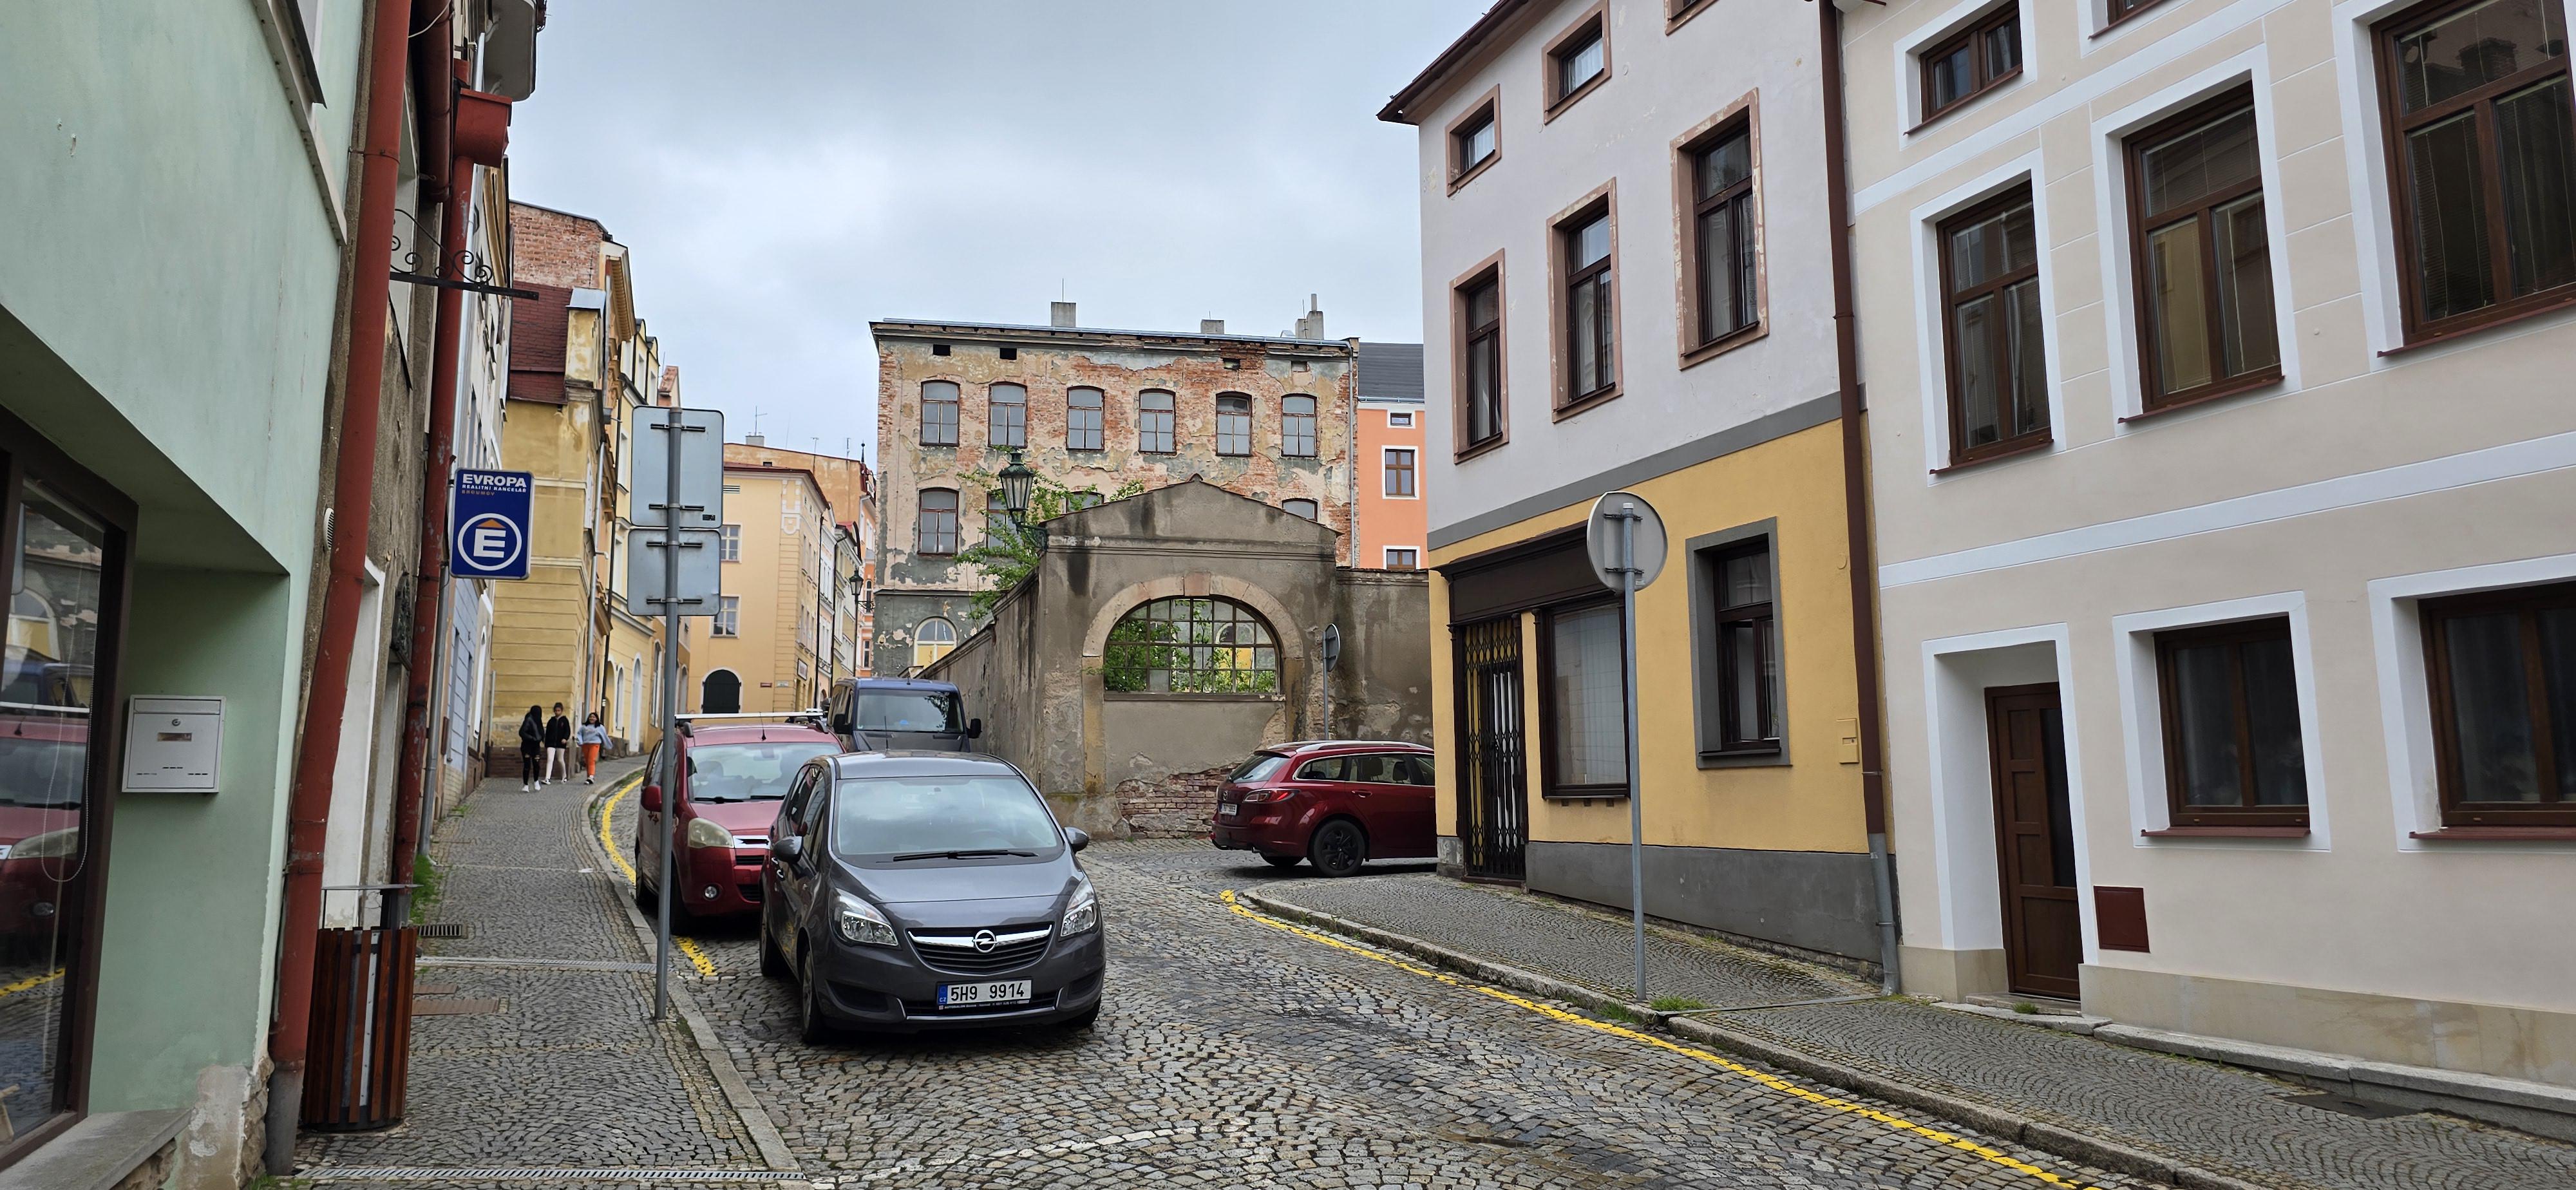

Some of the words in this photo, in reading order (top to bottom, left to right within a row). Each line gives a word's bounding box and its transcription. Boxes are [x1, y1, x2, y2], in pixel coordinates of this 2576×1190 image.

[463, 473, 527, 487] EVROPA
[473, 528, 506, 558] E
[951, 985, 978, 1001] 5H9
[989, 982, 1025, 999] 9914
